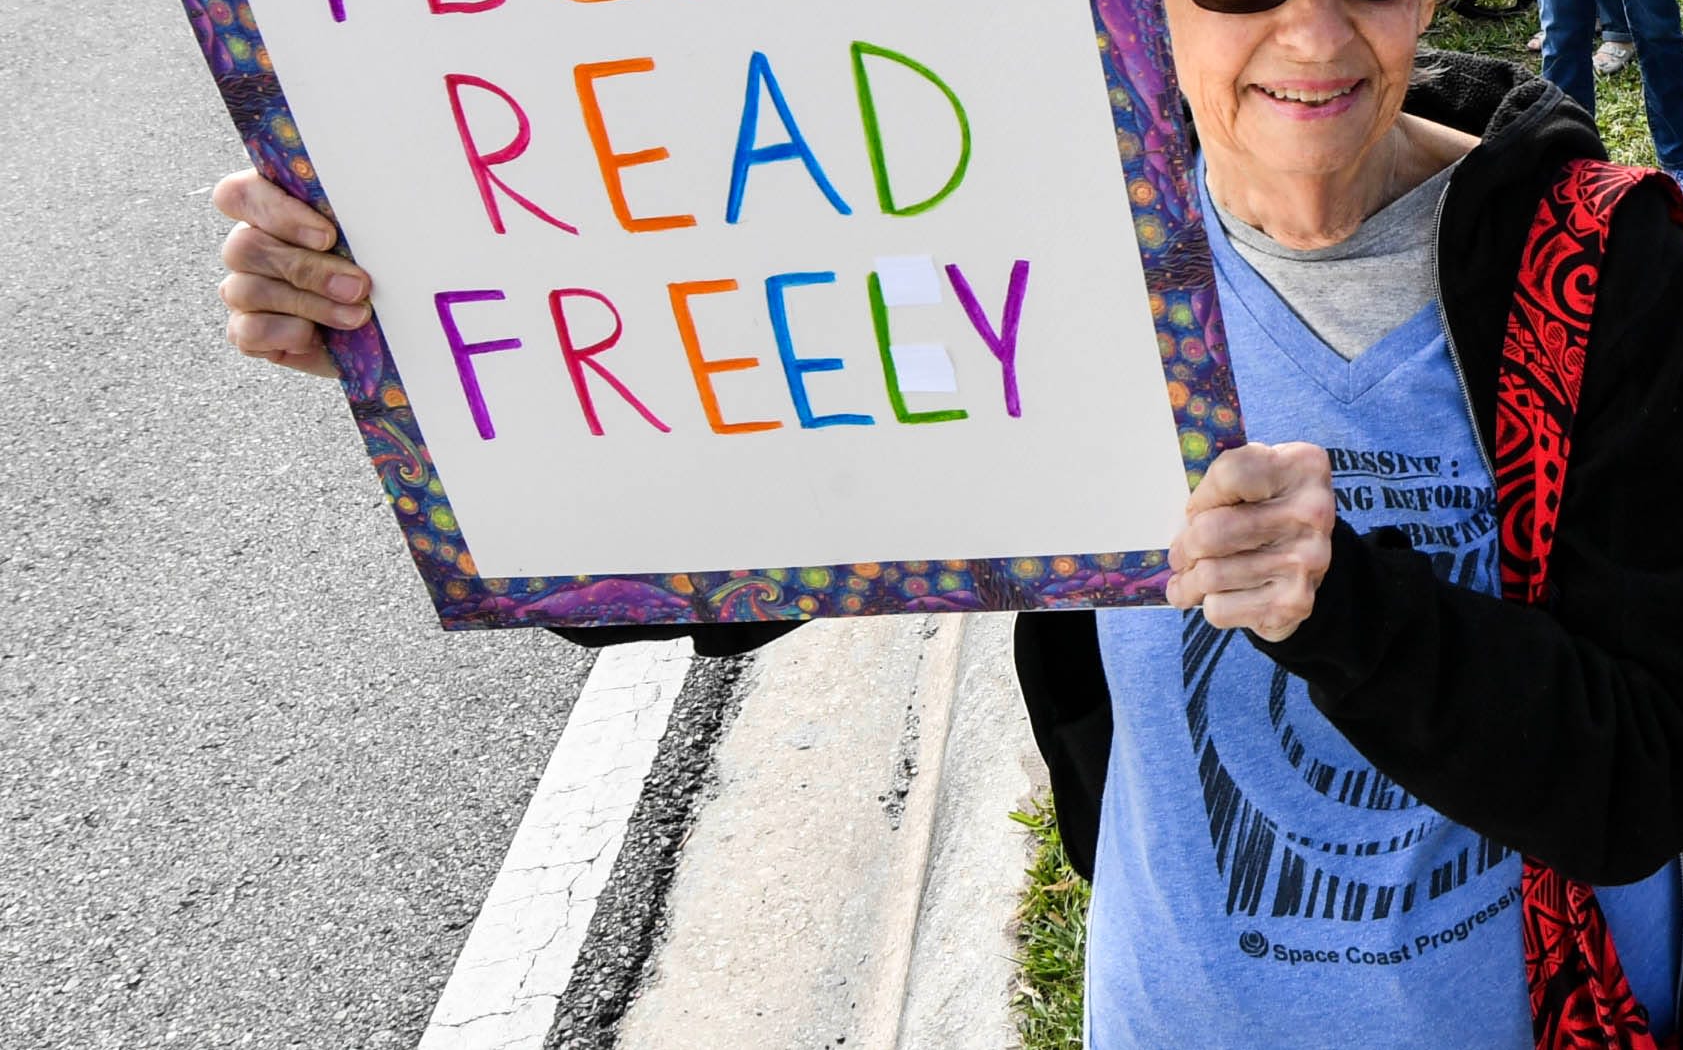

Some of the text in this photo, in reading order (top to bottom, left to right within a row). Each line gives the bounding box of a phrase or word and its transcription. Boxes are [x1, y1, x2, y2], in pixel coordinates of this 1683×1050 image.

[445, 40, 973, 237] READ
[434, 259, 1031, 442] FREELY
[1327, 448, 1441, 475] RESSIVE
[1335, 485, 1374, 511] NG
[1273, 886, 1523, 965] Space Coast Progressiv
